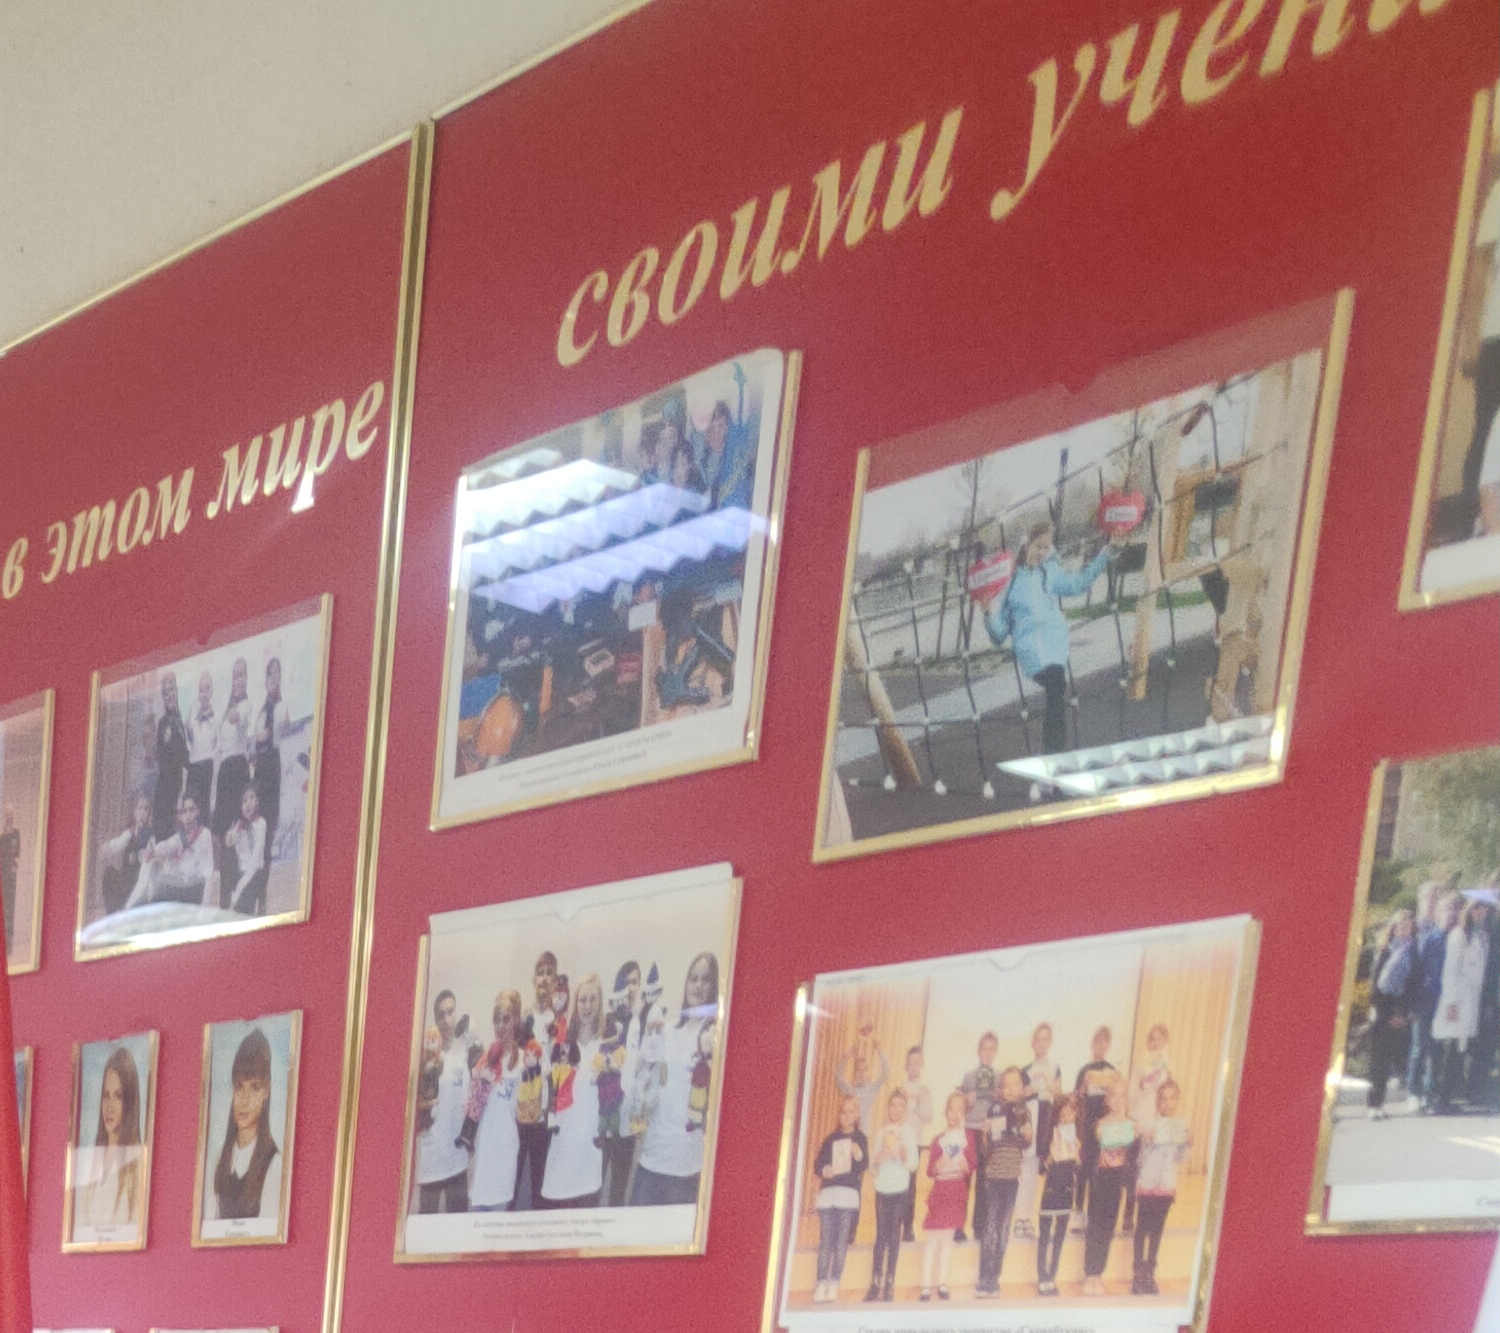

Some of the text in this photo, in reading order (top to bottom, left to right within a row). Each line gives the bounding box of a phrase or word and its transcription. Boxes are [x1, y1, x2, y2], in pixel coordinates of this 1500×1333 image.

[555, 0, 1449, 367] своими учен
[1, 534, 29, 600] в
[38, 465, 195, 584] этом
[206, 380, 385, 514] мире
